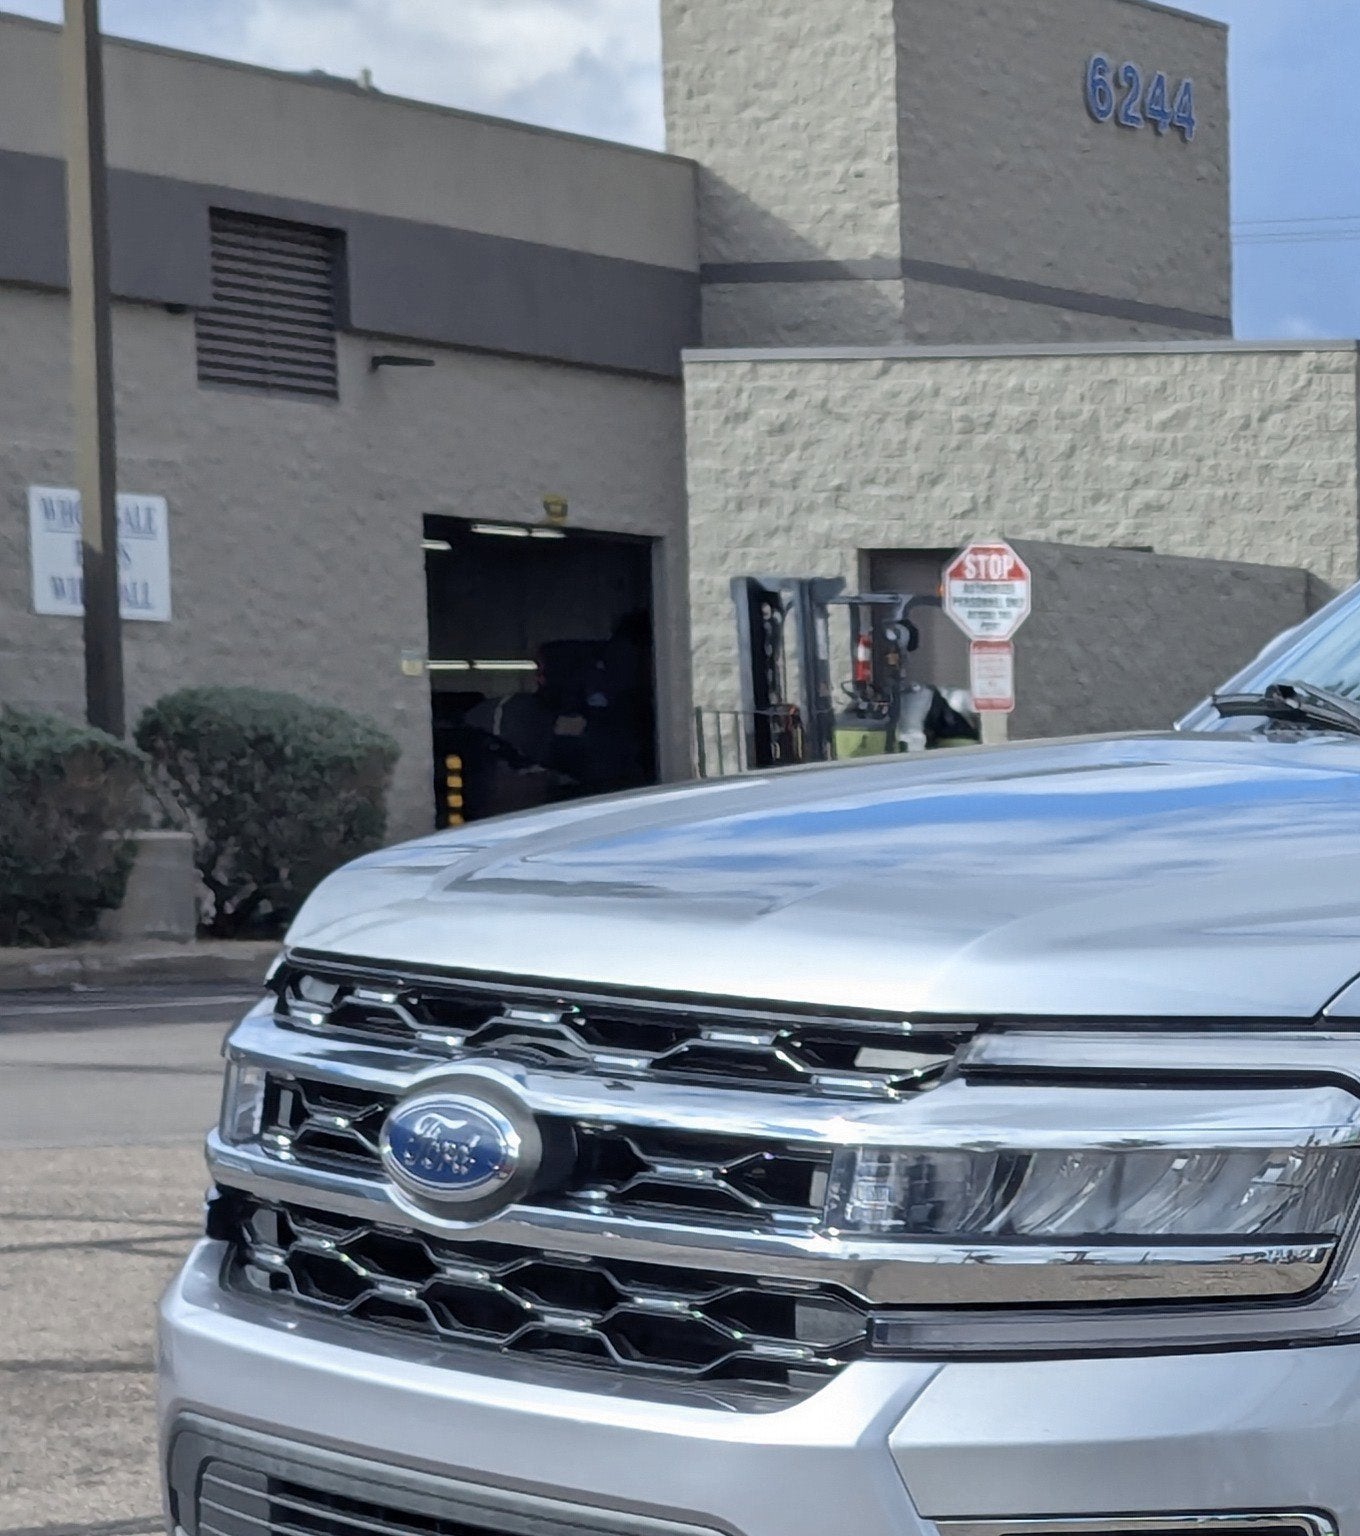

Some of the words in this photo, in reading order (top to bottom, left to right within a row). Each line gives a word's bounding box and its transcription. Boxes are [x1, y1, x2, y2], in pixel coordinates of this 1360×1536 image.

[1087, 53, 1196, 141] 6244
[40, 497, 158, 536] WHALE
[964, 553, 1015, 580] STOP
